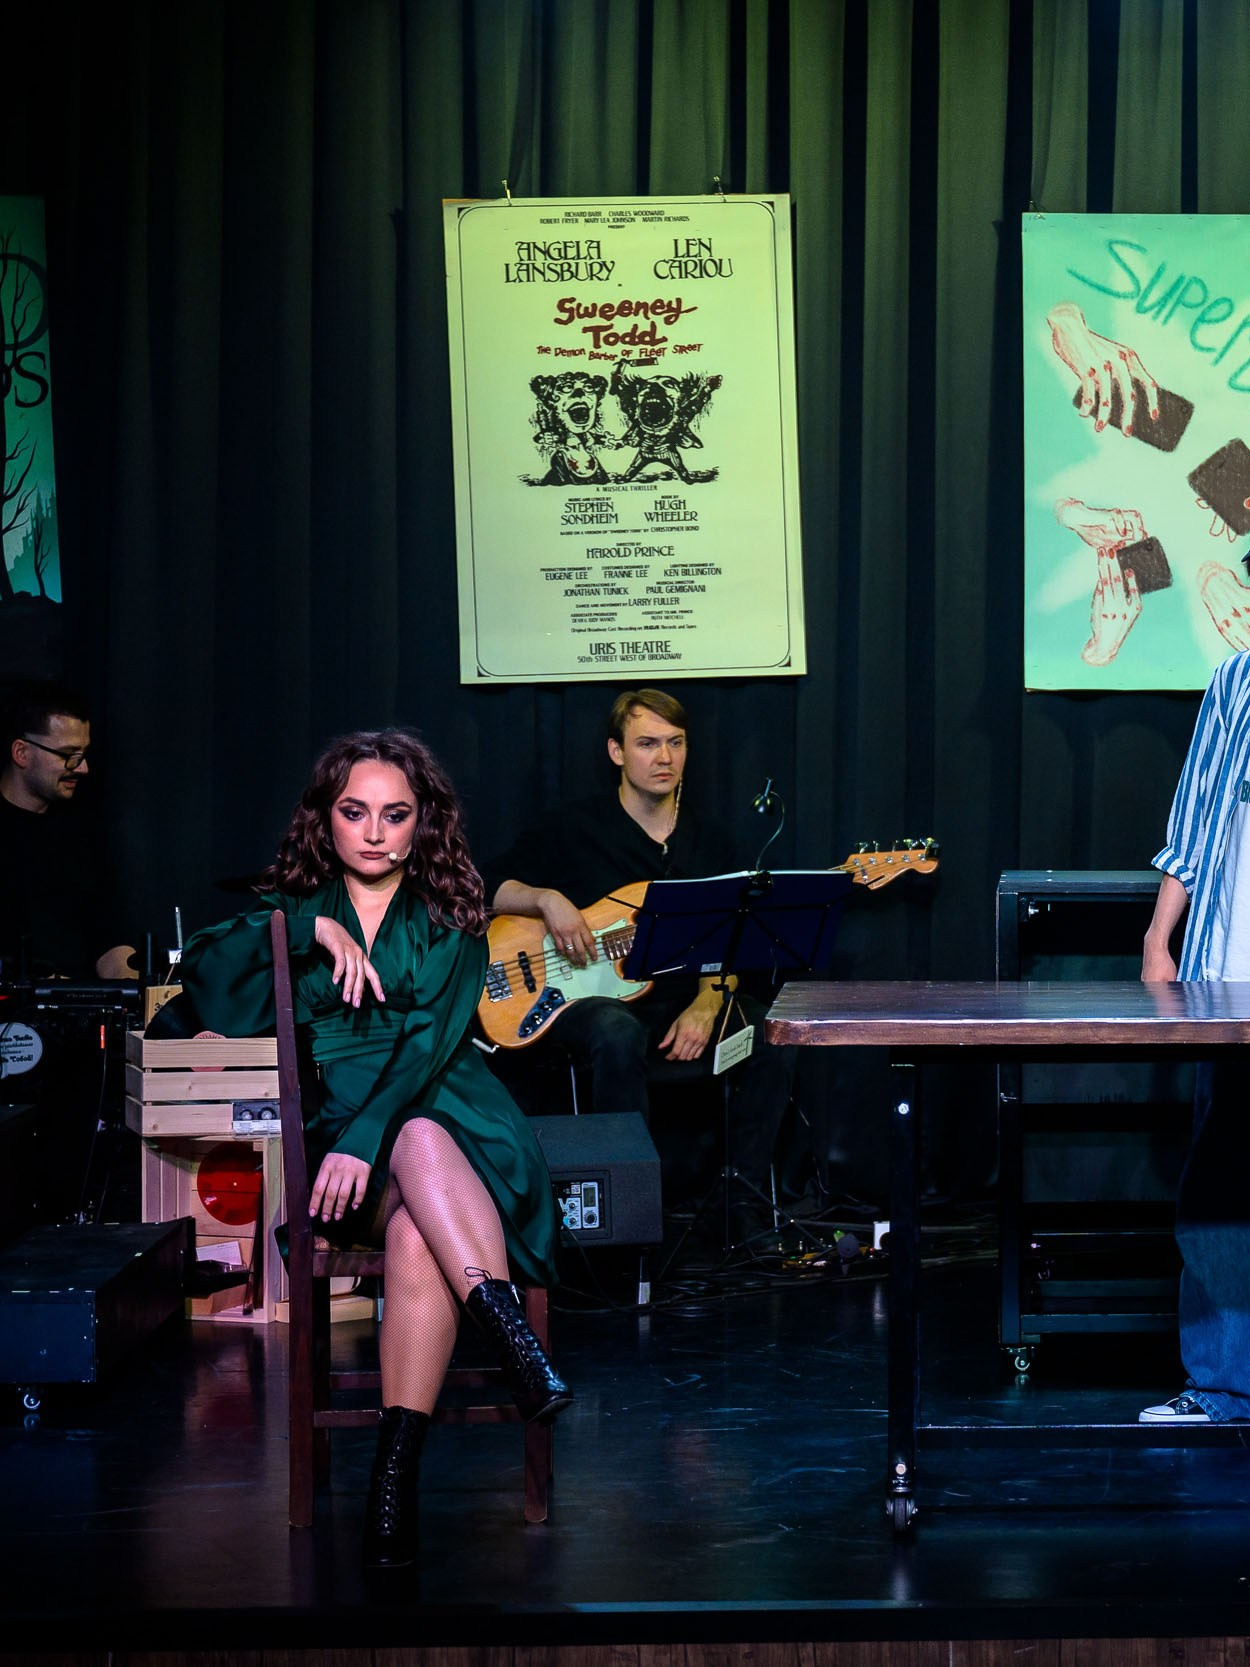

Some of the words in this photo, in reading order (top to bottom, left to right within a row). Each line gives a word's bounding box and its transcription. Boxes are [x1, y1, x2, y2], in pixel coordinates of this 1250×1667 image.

[515, 240, 602, 262] ANGELA
[673, 238, 714, 259] LEN
[504, 260, 615, 284] LANSBURY
[654, 258, 734, 280] CARIOU
[554, 296, 698, 326] Sweeney
[582, 320, 668, 349] Todd
[564, 502, 614, 513] STEPHEN
[654, 500, 686, 511] HUGH
[561, 513, 618, 525] SONDHEIM
[644, 511, 698, 522] WHEELER
[586, 548, 631, 559] HAROLD
[634, 546, 675, 557] PRINCE
[545, 572, 573, 581] EUGENE
[575, 572, 588, 580] LEE
[604, 570, 632, 579] FRANNE
[636, 569, 648, 578] LEE
[664, 569, 679, 577] KEN
[681, 568, 722, 576] BILLINGTON
[563, 588, 600, 597] JONATHAN
[603, 587, 629, 596] TUNICK
[646, 586, 662, 594] PAUL
[665, 585, 706, 594] GEMIGNANI
[628, 598, 652, 607] LARRY
[654, 597, 680, 606] FULLER
[589, 642, 616, 655] URIS
[620, 640, 671, 654] THEATRE
